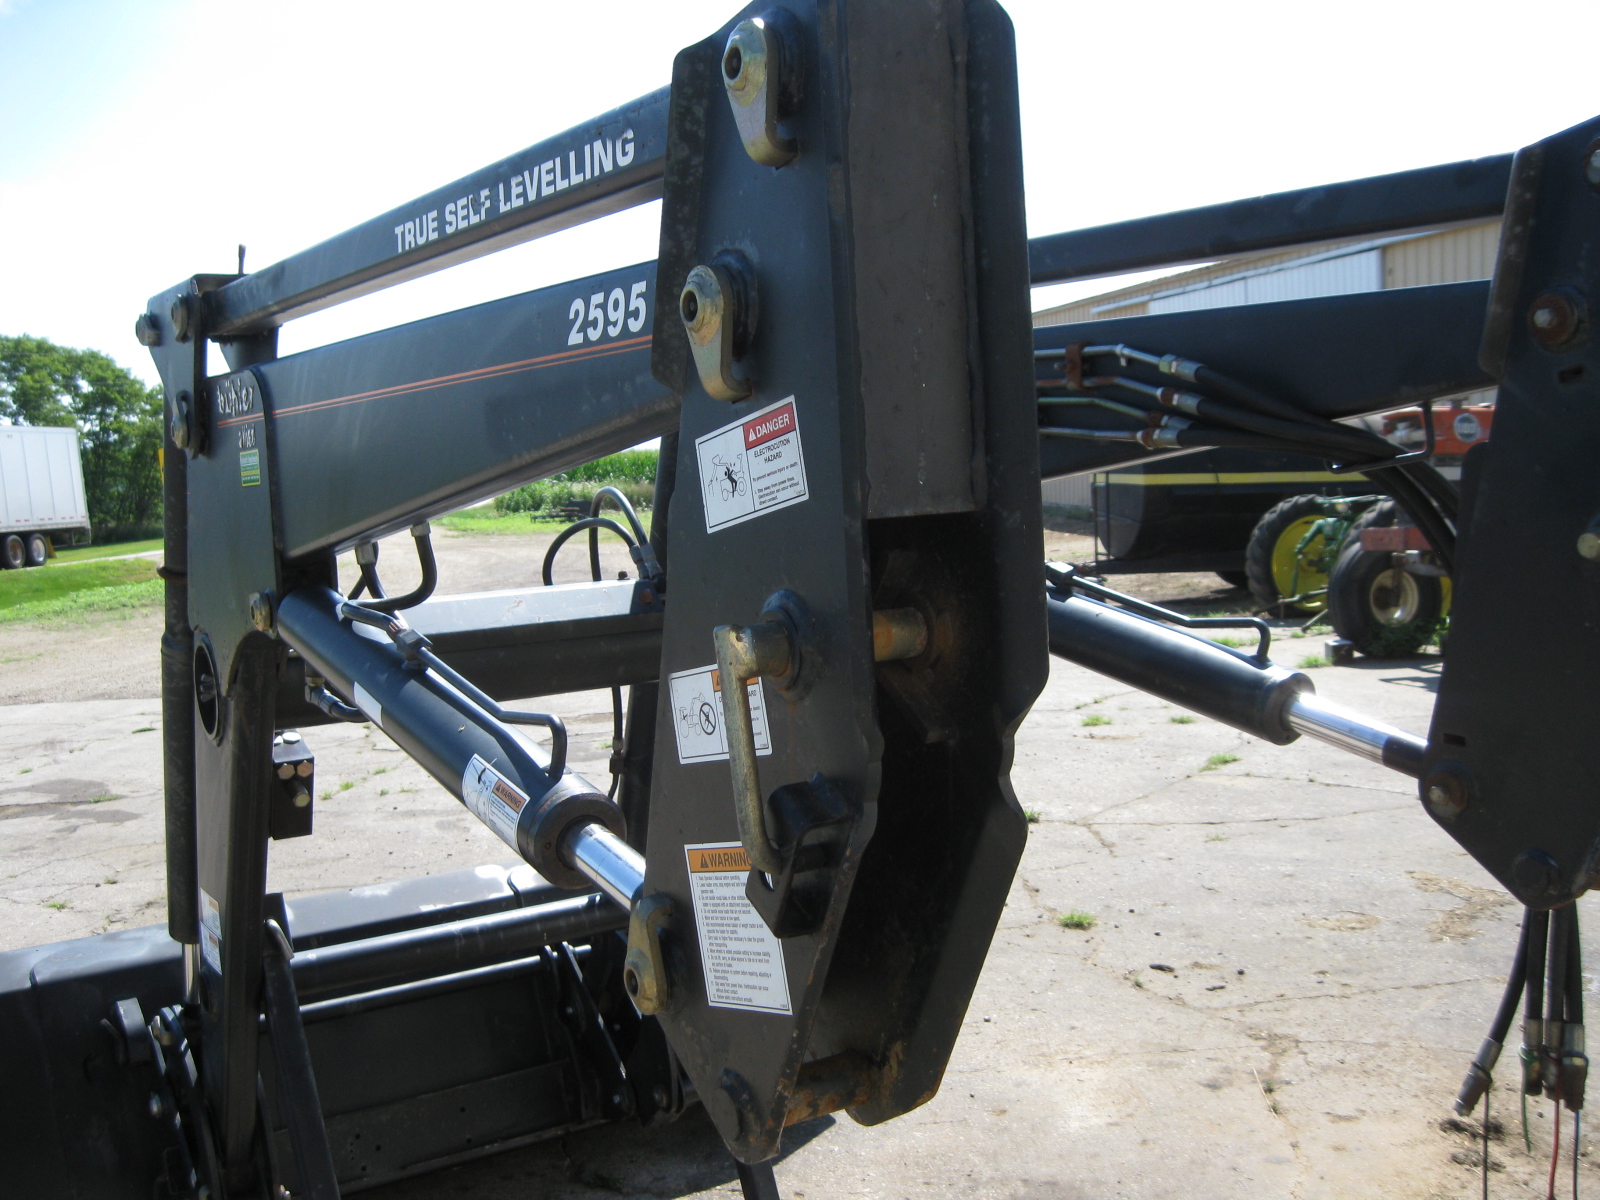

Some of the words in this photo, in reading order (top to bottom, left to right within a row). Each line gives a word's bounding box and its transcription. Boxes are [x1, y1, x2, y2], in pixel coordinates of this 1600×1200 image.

[394, 210, 439, 253] TRUE
[445, 187, 491, 234] SELF
[499, 128, 635, 213] LEVELLING
[567, 280, 647, 346] 2595
[756, 413, 790, 438] DANGER
[753, 436, 791, 458] ELECTROCUTION
[763, 451, 783, 464] HAZARD
[500, 786, 522, 808] WARNING
